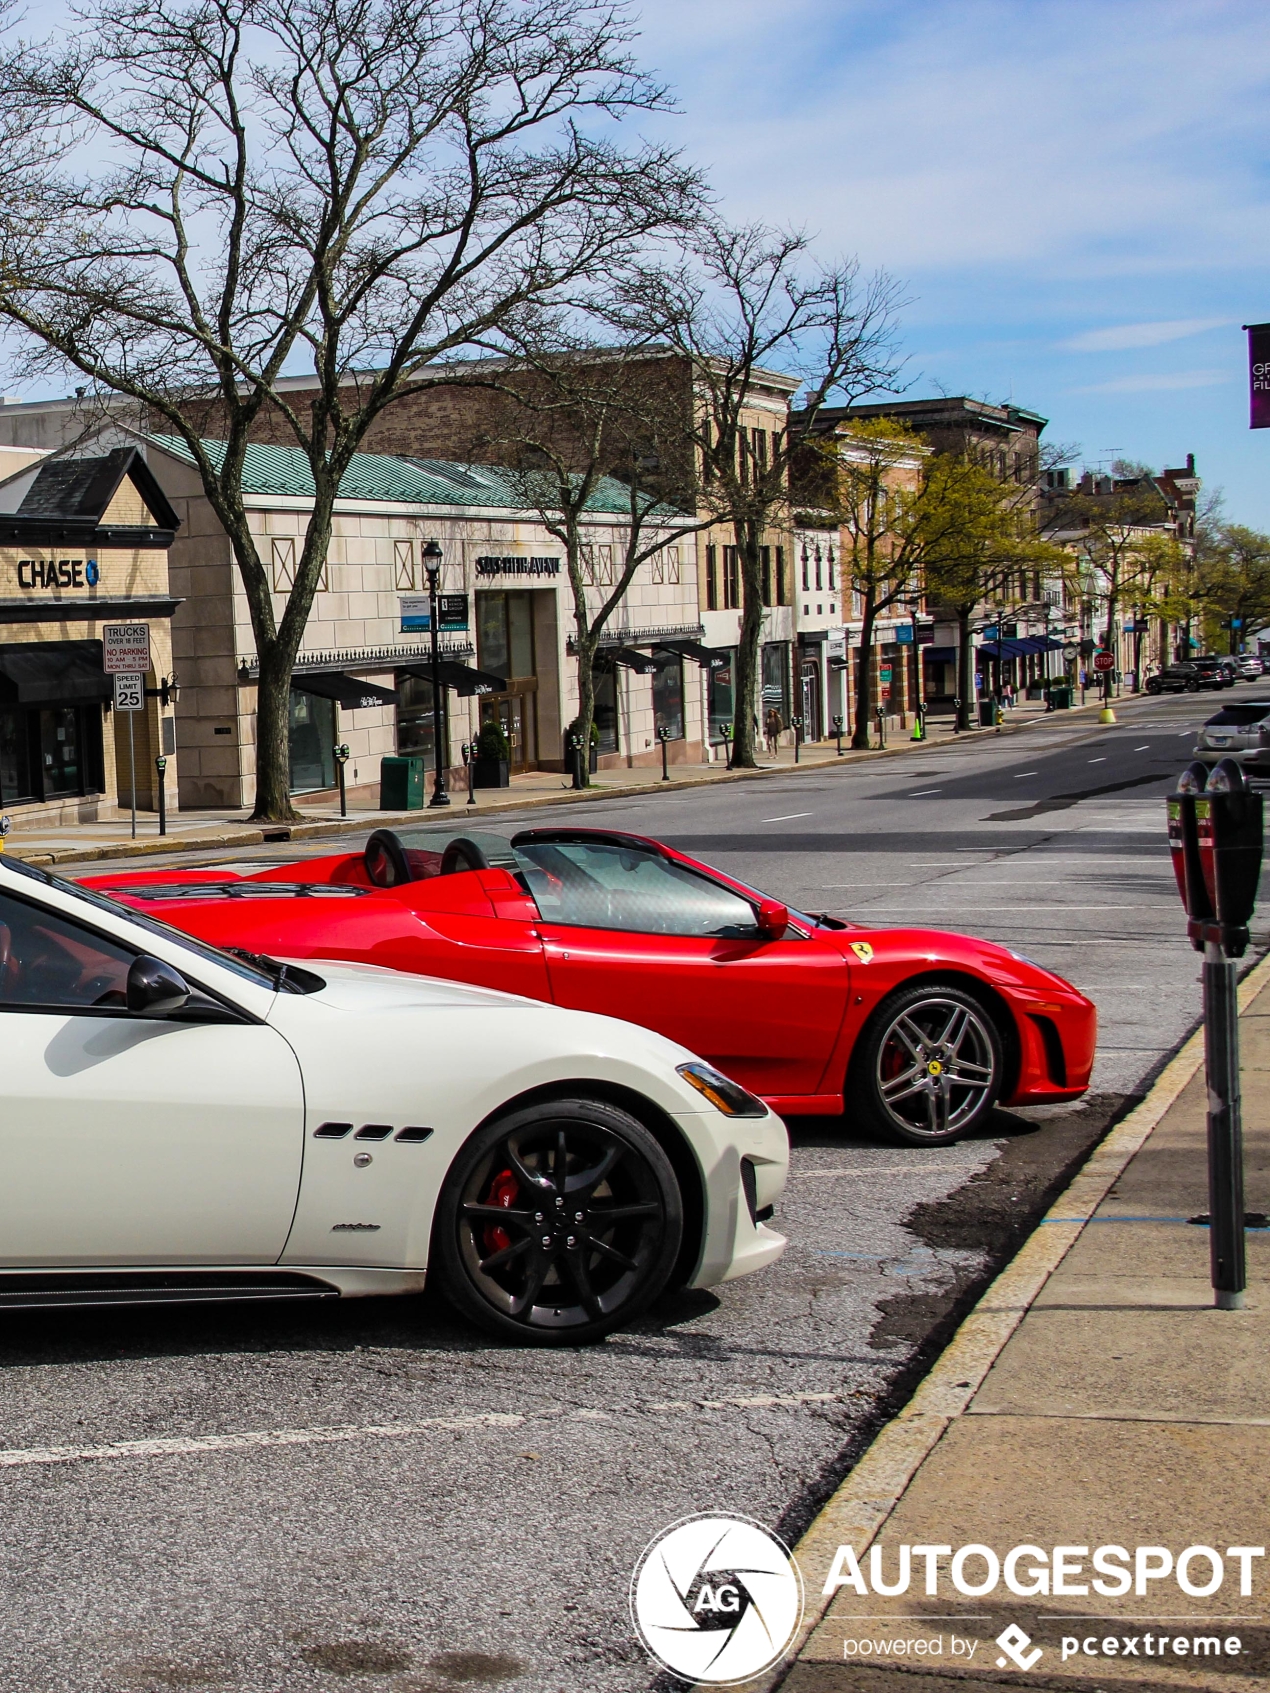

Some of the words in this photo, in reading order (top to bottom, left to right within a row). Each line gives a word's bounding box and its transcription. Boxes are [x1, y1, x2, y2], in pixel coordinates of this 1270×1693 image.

[17, 560, 85, 589] CHASE
[107, 626, 146, 637] TRUCKS
[106, 648, 116, 657] NO
[119, 647, 148, 656] PARKING
[1095, 657, 1113, 666] STOP
[118, 691, 140, 706] 25
